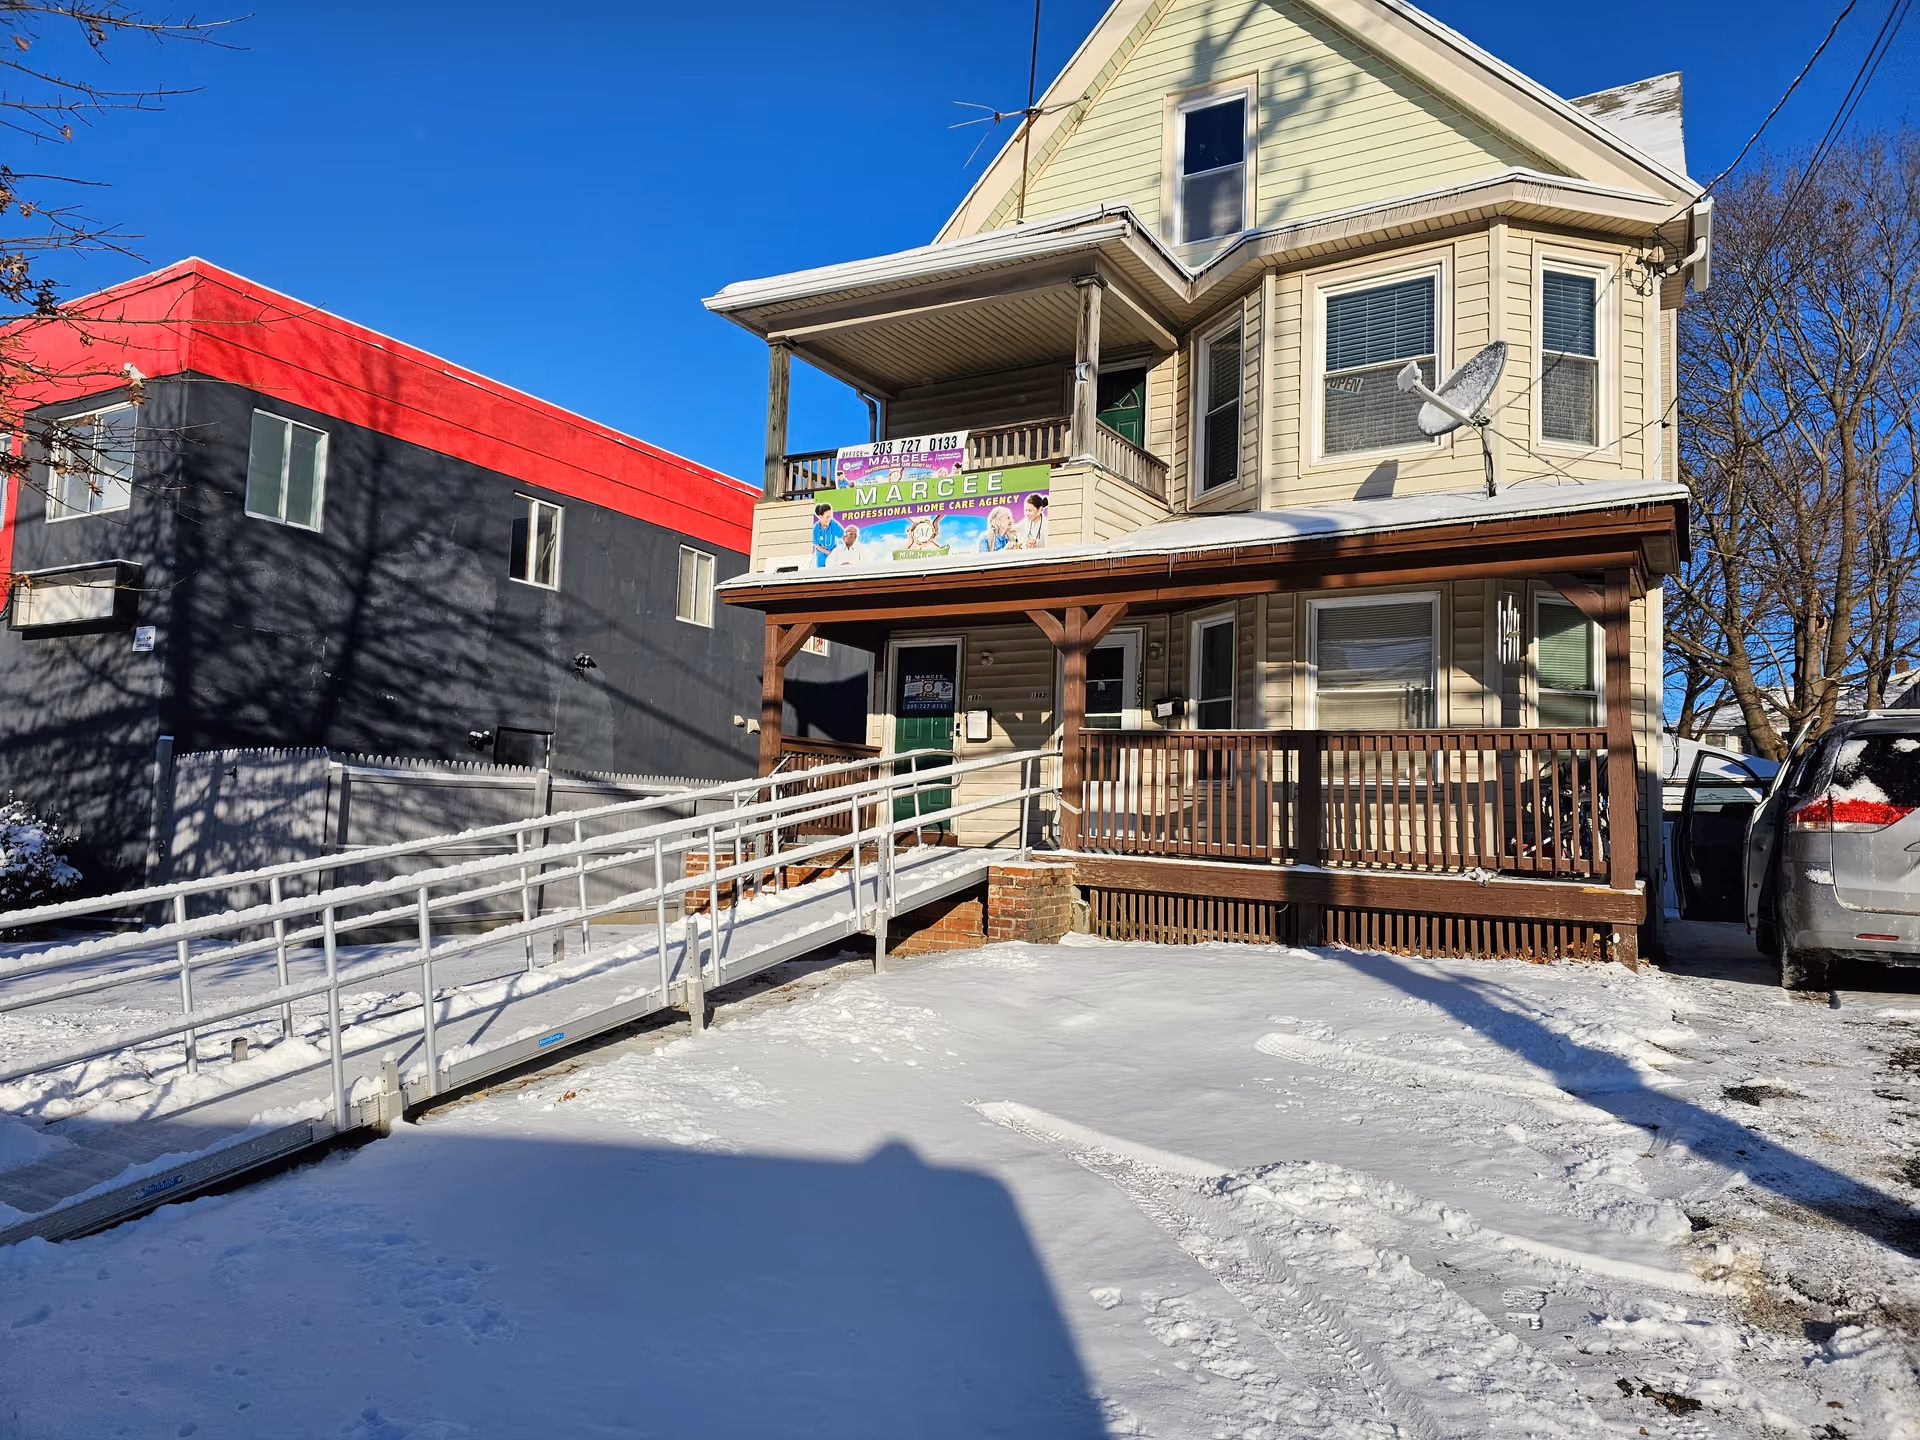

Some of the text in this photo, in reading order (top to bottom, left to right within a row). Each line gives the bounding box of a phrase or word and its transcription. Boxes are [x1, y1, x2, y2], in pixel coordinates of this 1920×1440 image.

[1330, 376, 1361, 392] OPEN
[873, 442, 893, 456] 203
[900, 439, 921, 453] 727
[929, 436, 958, 452] 0133
[868, 453, 929, 466] MARCEE
[854, 471, 1004, 506] MARCEE
[841, 494, 1021, 521] PROFESSIONAL HOME CARE AGENCY
